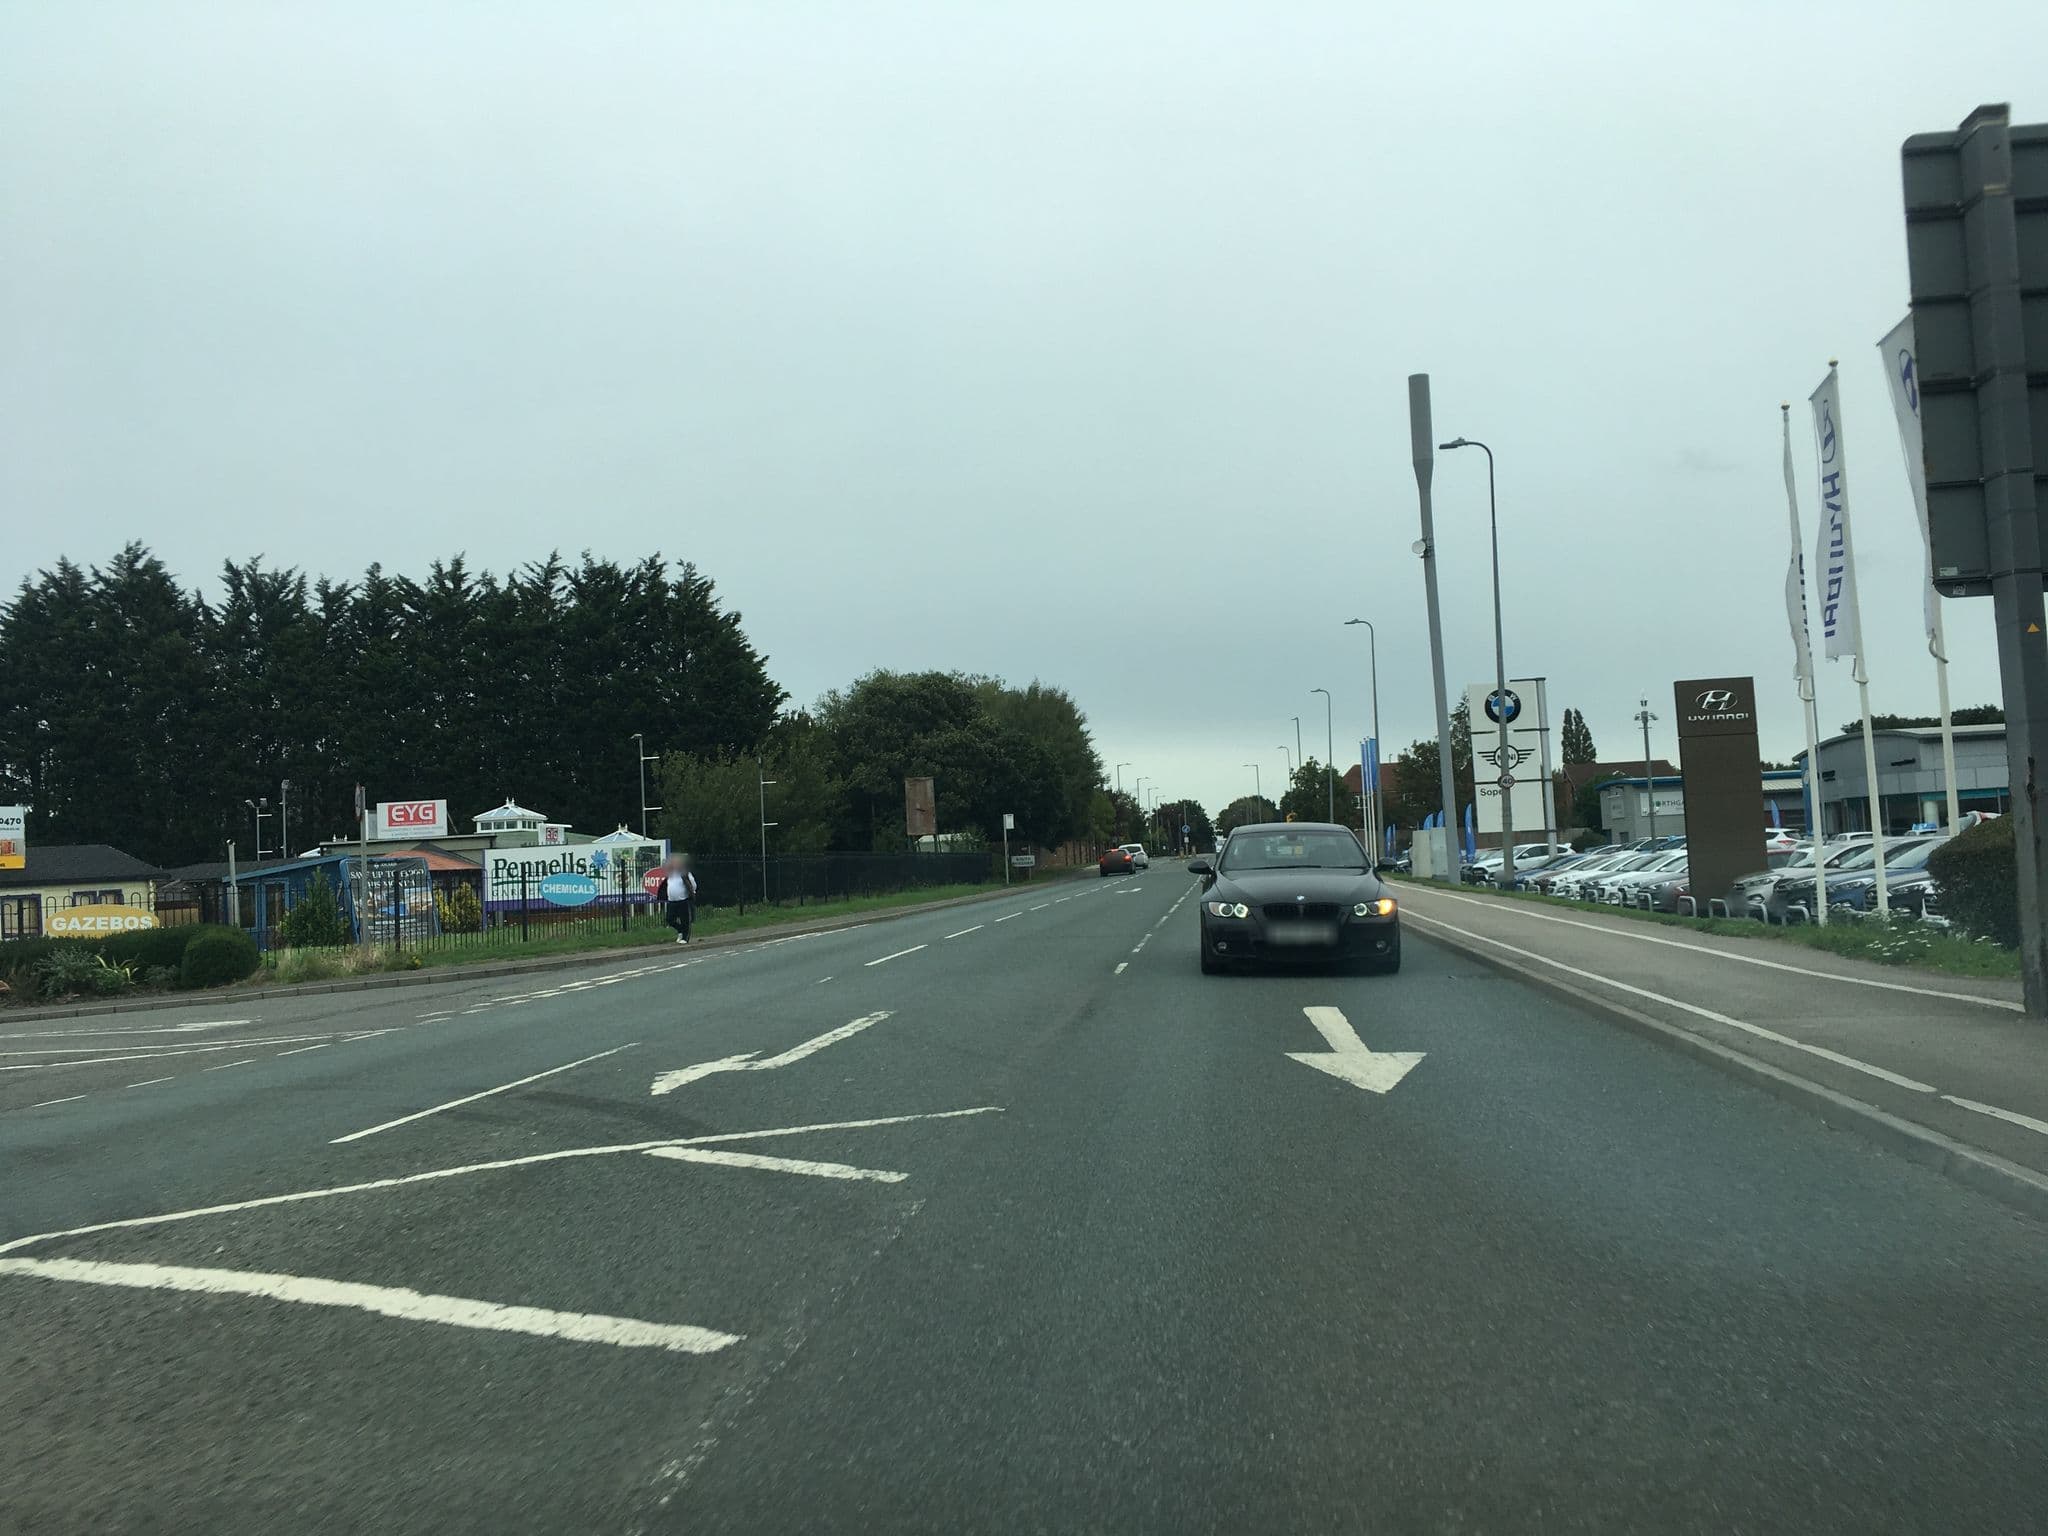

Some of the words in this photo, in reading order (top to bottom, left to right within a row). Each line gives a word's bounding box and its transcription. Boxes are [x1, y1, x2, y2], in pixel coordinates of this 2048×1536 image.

[1502, 777, 1513, 785] 40
[391, 804, 433, 822] EYG
[492, 851, 587, 879] Pennells
[542, 883, 596, 895] CHEMICALS
[644, 877, 660, 887] HOT
[51, 915, 153, 931] GAZEBOS
